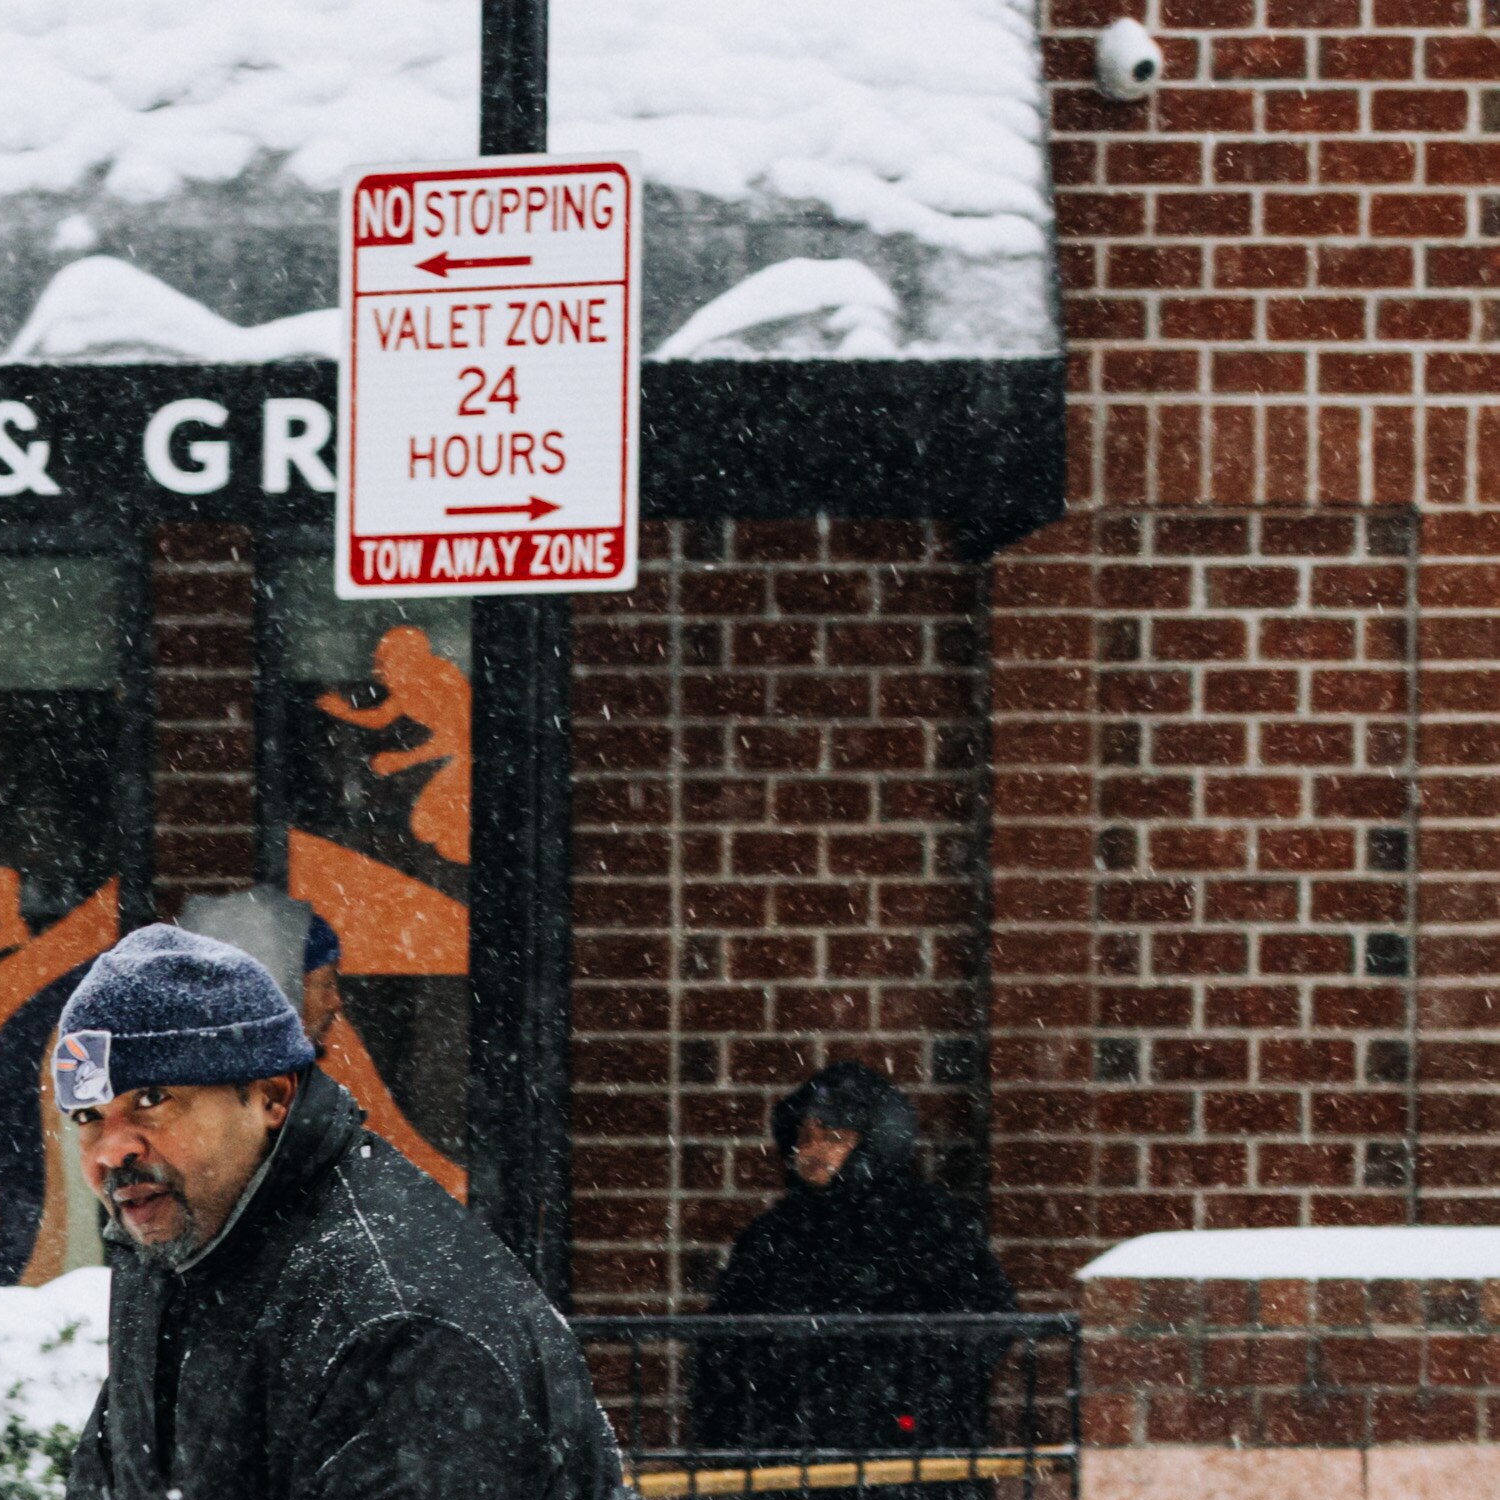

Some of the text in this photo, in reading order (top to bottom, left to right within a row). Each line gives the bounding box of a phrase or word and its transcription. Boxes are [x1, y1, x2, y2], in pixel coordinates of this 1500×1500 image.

[359, 182, 614, 239] NO STOPPING
[374, 298, 608, 351] VALET ZONE
[457, 365, 520, 416] 24
[408, 430, 567, 478] HOURS
[360, 533, 615, 581] TOW AWAY ZONE
